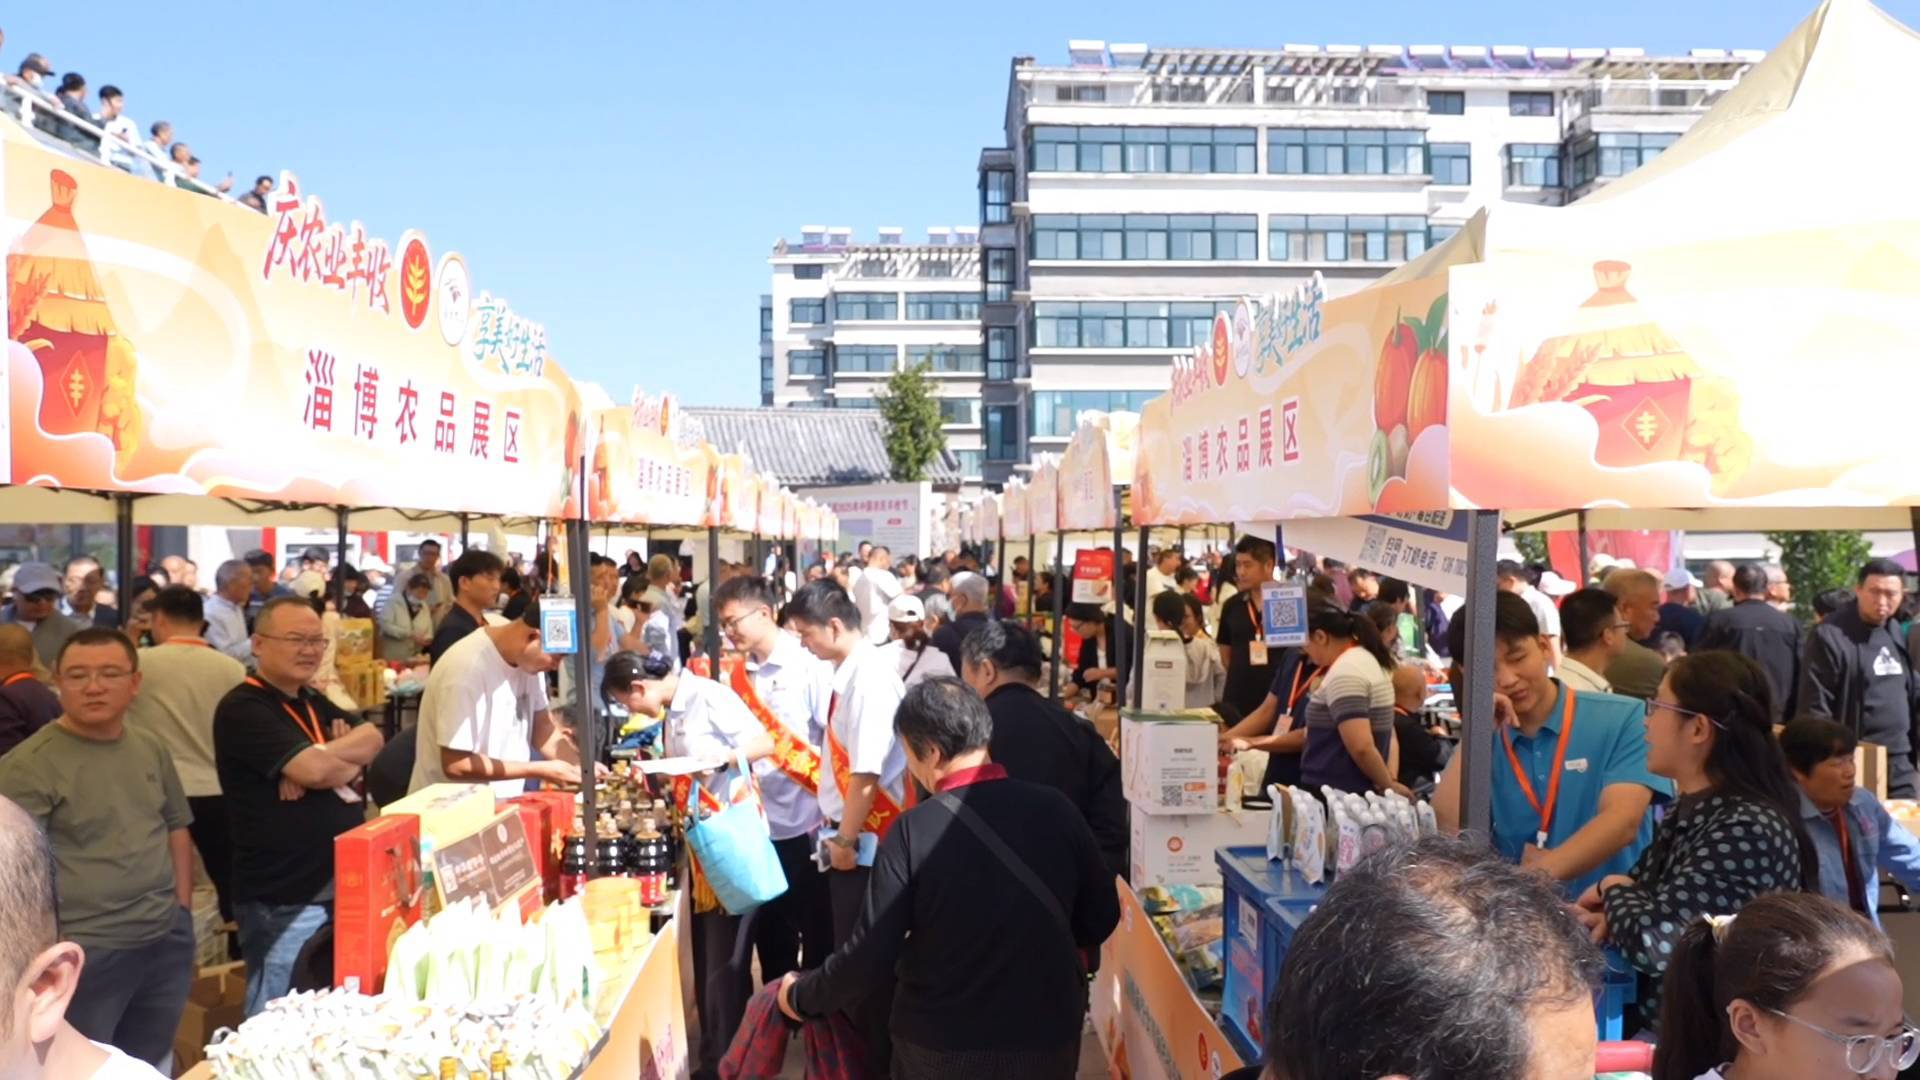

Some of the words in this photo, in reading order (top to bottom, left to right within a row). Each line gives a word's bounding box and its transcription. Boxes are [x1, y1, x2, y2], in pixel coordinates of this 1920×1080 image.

[263, 179, 391, 315] 庆农业丰收
[474, 296, 546, 377] 享美好生活
[303, 349, 520, 464] 淄博农品展区
[1182, 400, 1299, 483] 淄博农品展区
